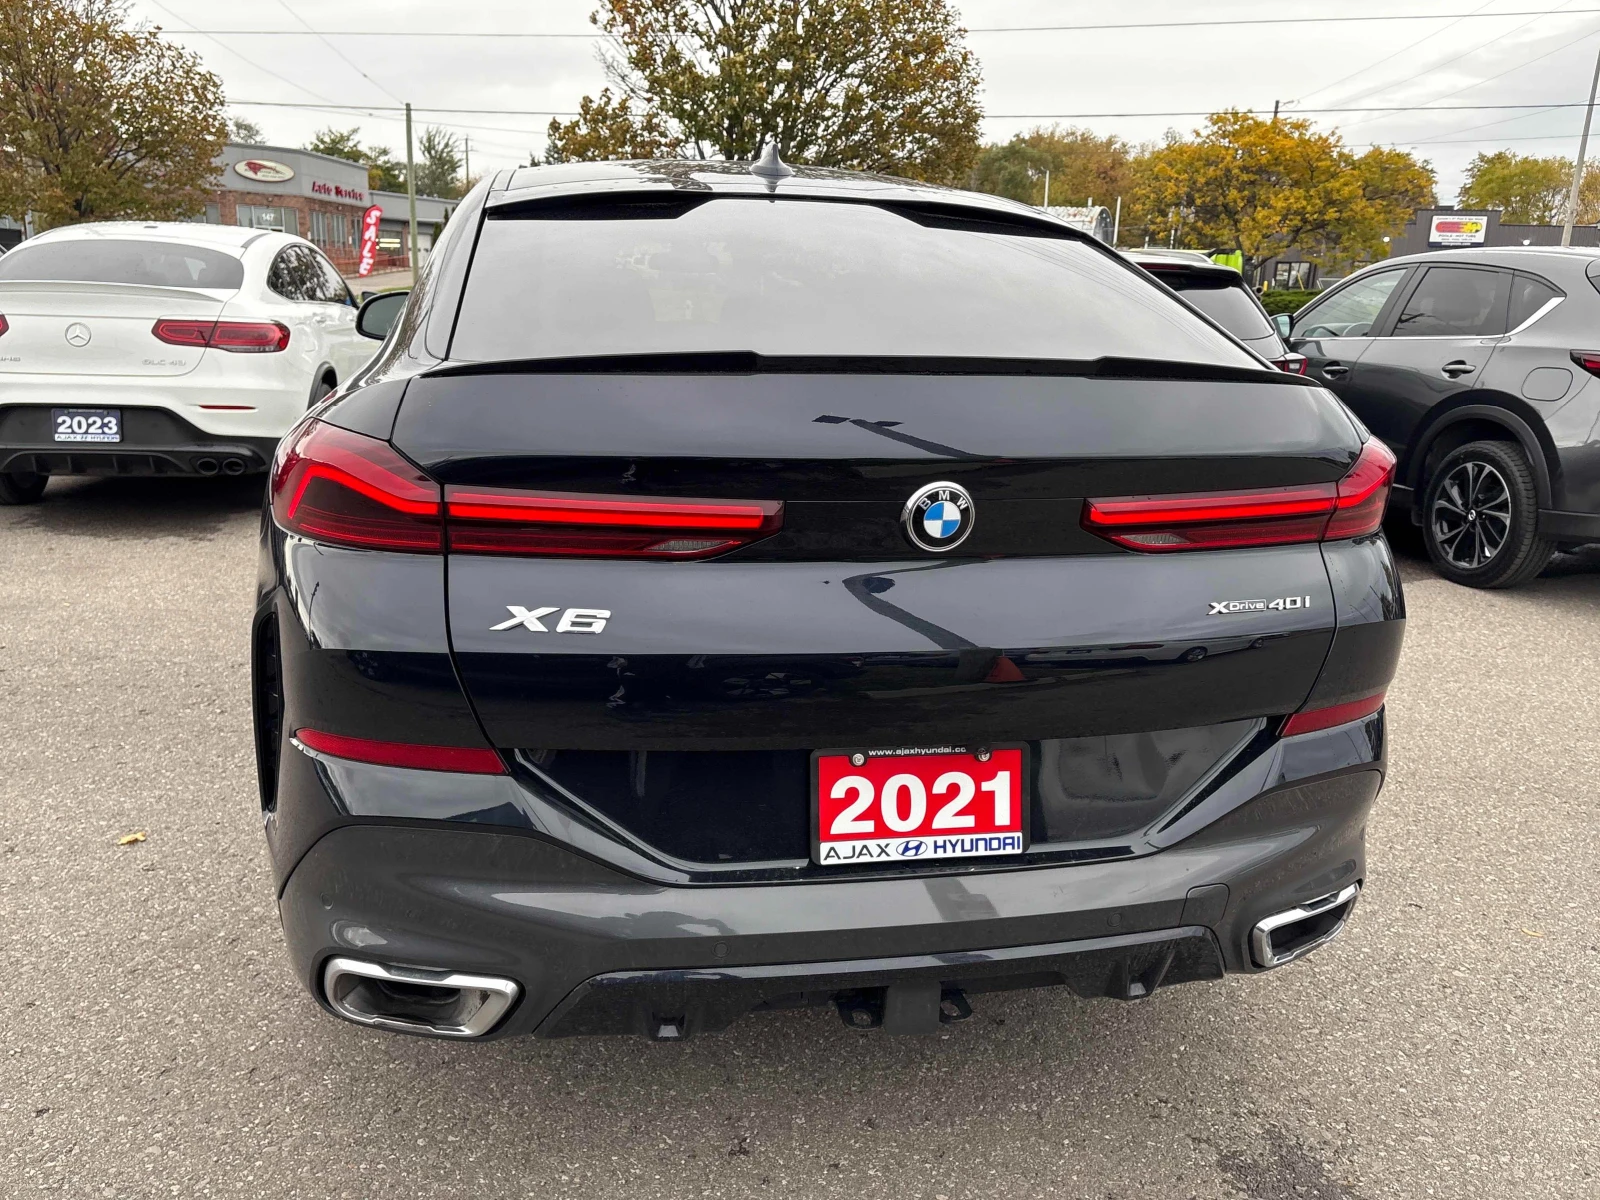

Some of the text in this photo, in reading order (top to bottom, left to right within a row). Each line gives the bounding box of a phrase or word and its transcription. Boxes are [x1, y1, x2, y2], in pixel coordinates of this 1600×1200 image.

[312, 181, 364, 201] Auto Service
[262, 213, 275, 221] 147
[358, 209, 382, 275] SALE
[56, 415, 118, 434] 2023
[918, 490, 969, 511] BMW
[488, 605, 612, 634] X6
[830, 771, 1011, 835] 2021
[823, 836, 1021, 861] AJAX HYUNDAI
